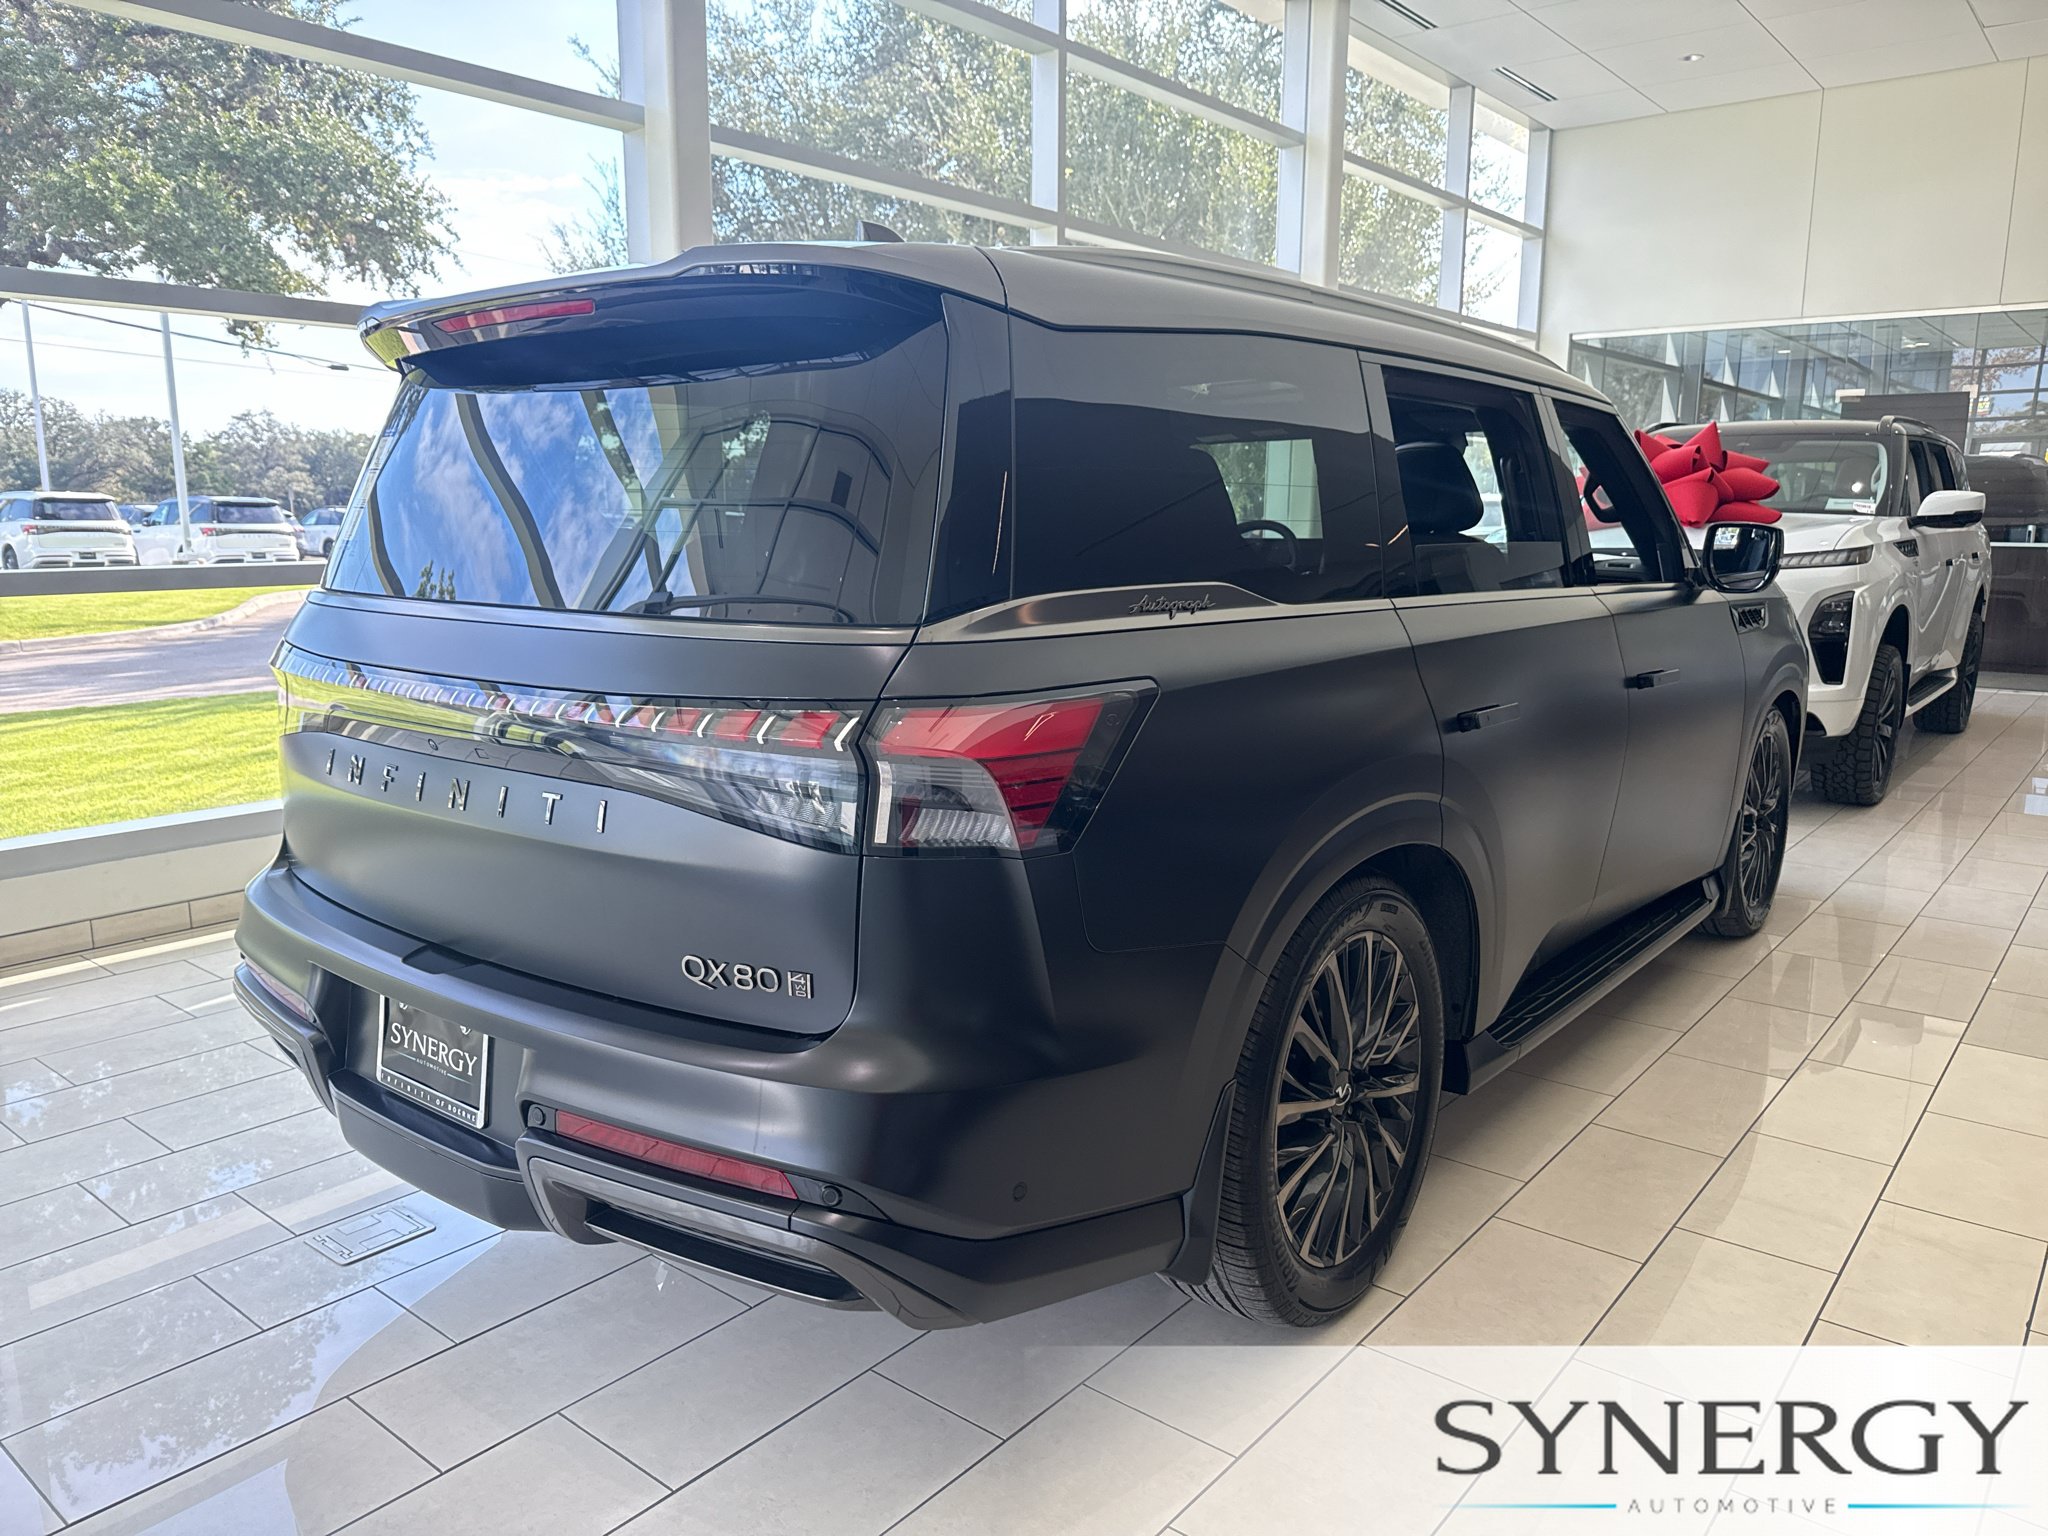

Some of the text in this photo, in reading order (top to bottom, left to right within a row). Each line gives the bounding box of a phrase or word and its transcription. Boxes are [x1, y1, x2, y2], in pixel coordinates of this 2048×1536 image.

[1128, 593, 1216, 620] Autograph
[326, 748, 608, 833] INFINITI
[681, 954, 781, 993] QX80
[390, 1022, 478, 1077] SYNERGY
[435, 1098, 445, 1107] OF
[447, 1103, 477, 1122] BOERNE
